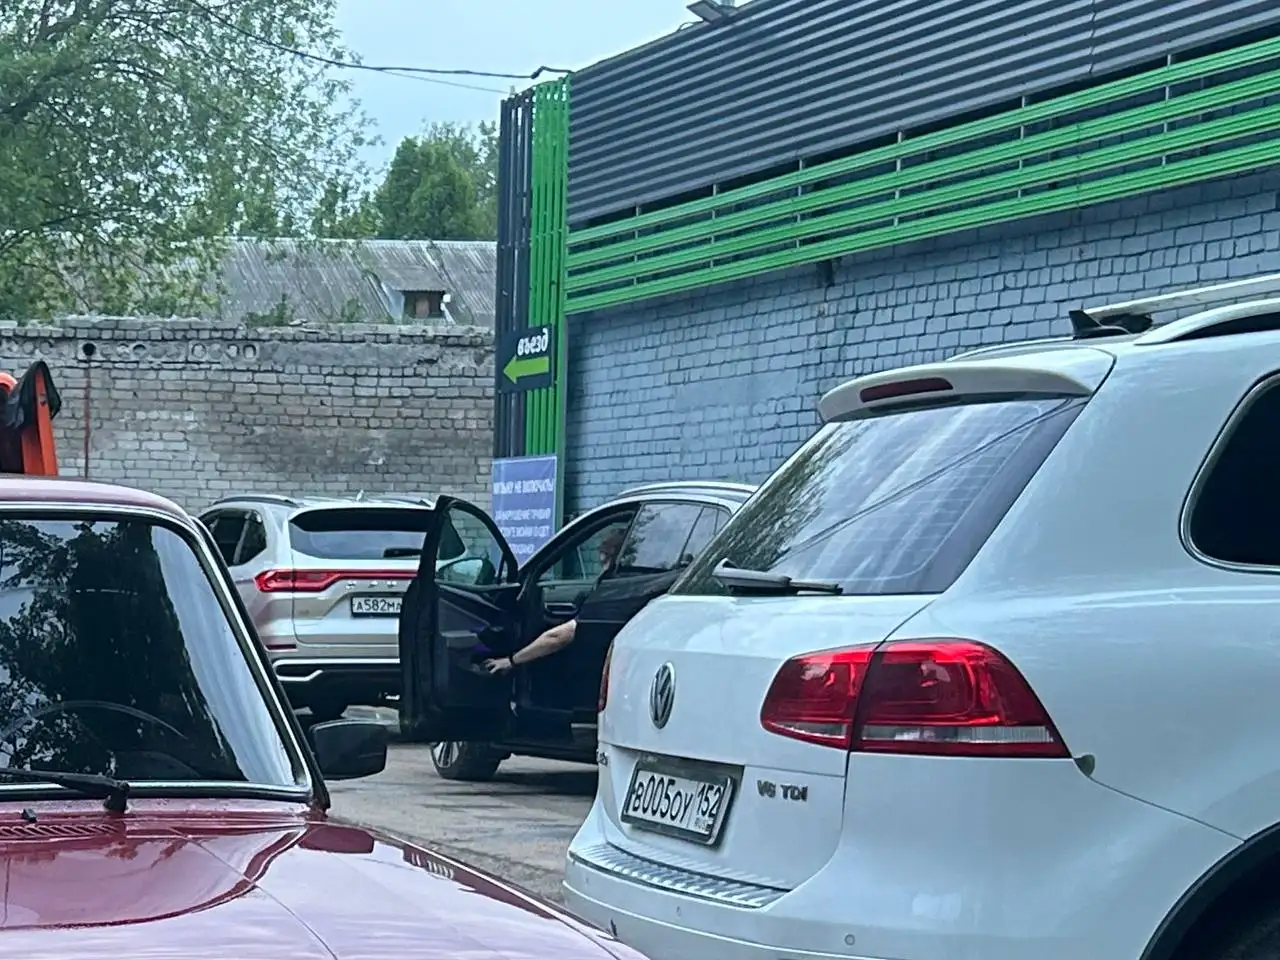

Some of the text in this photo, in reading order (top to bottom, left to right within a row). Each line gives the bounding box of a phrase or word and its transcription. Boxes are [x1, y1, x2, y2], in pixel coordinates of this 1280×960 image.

[697, 783, 722, 818] 152
[757, 779, 808, 802] V6 TDI
